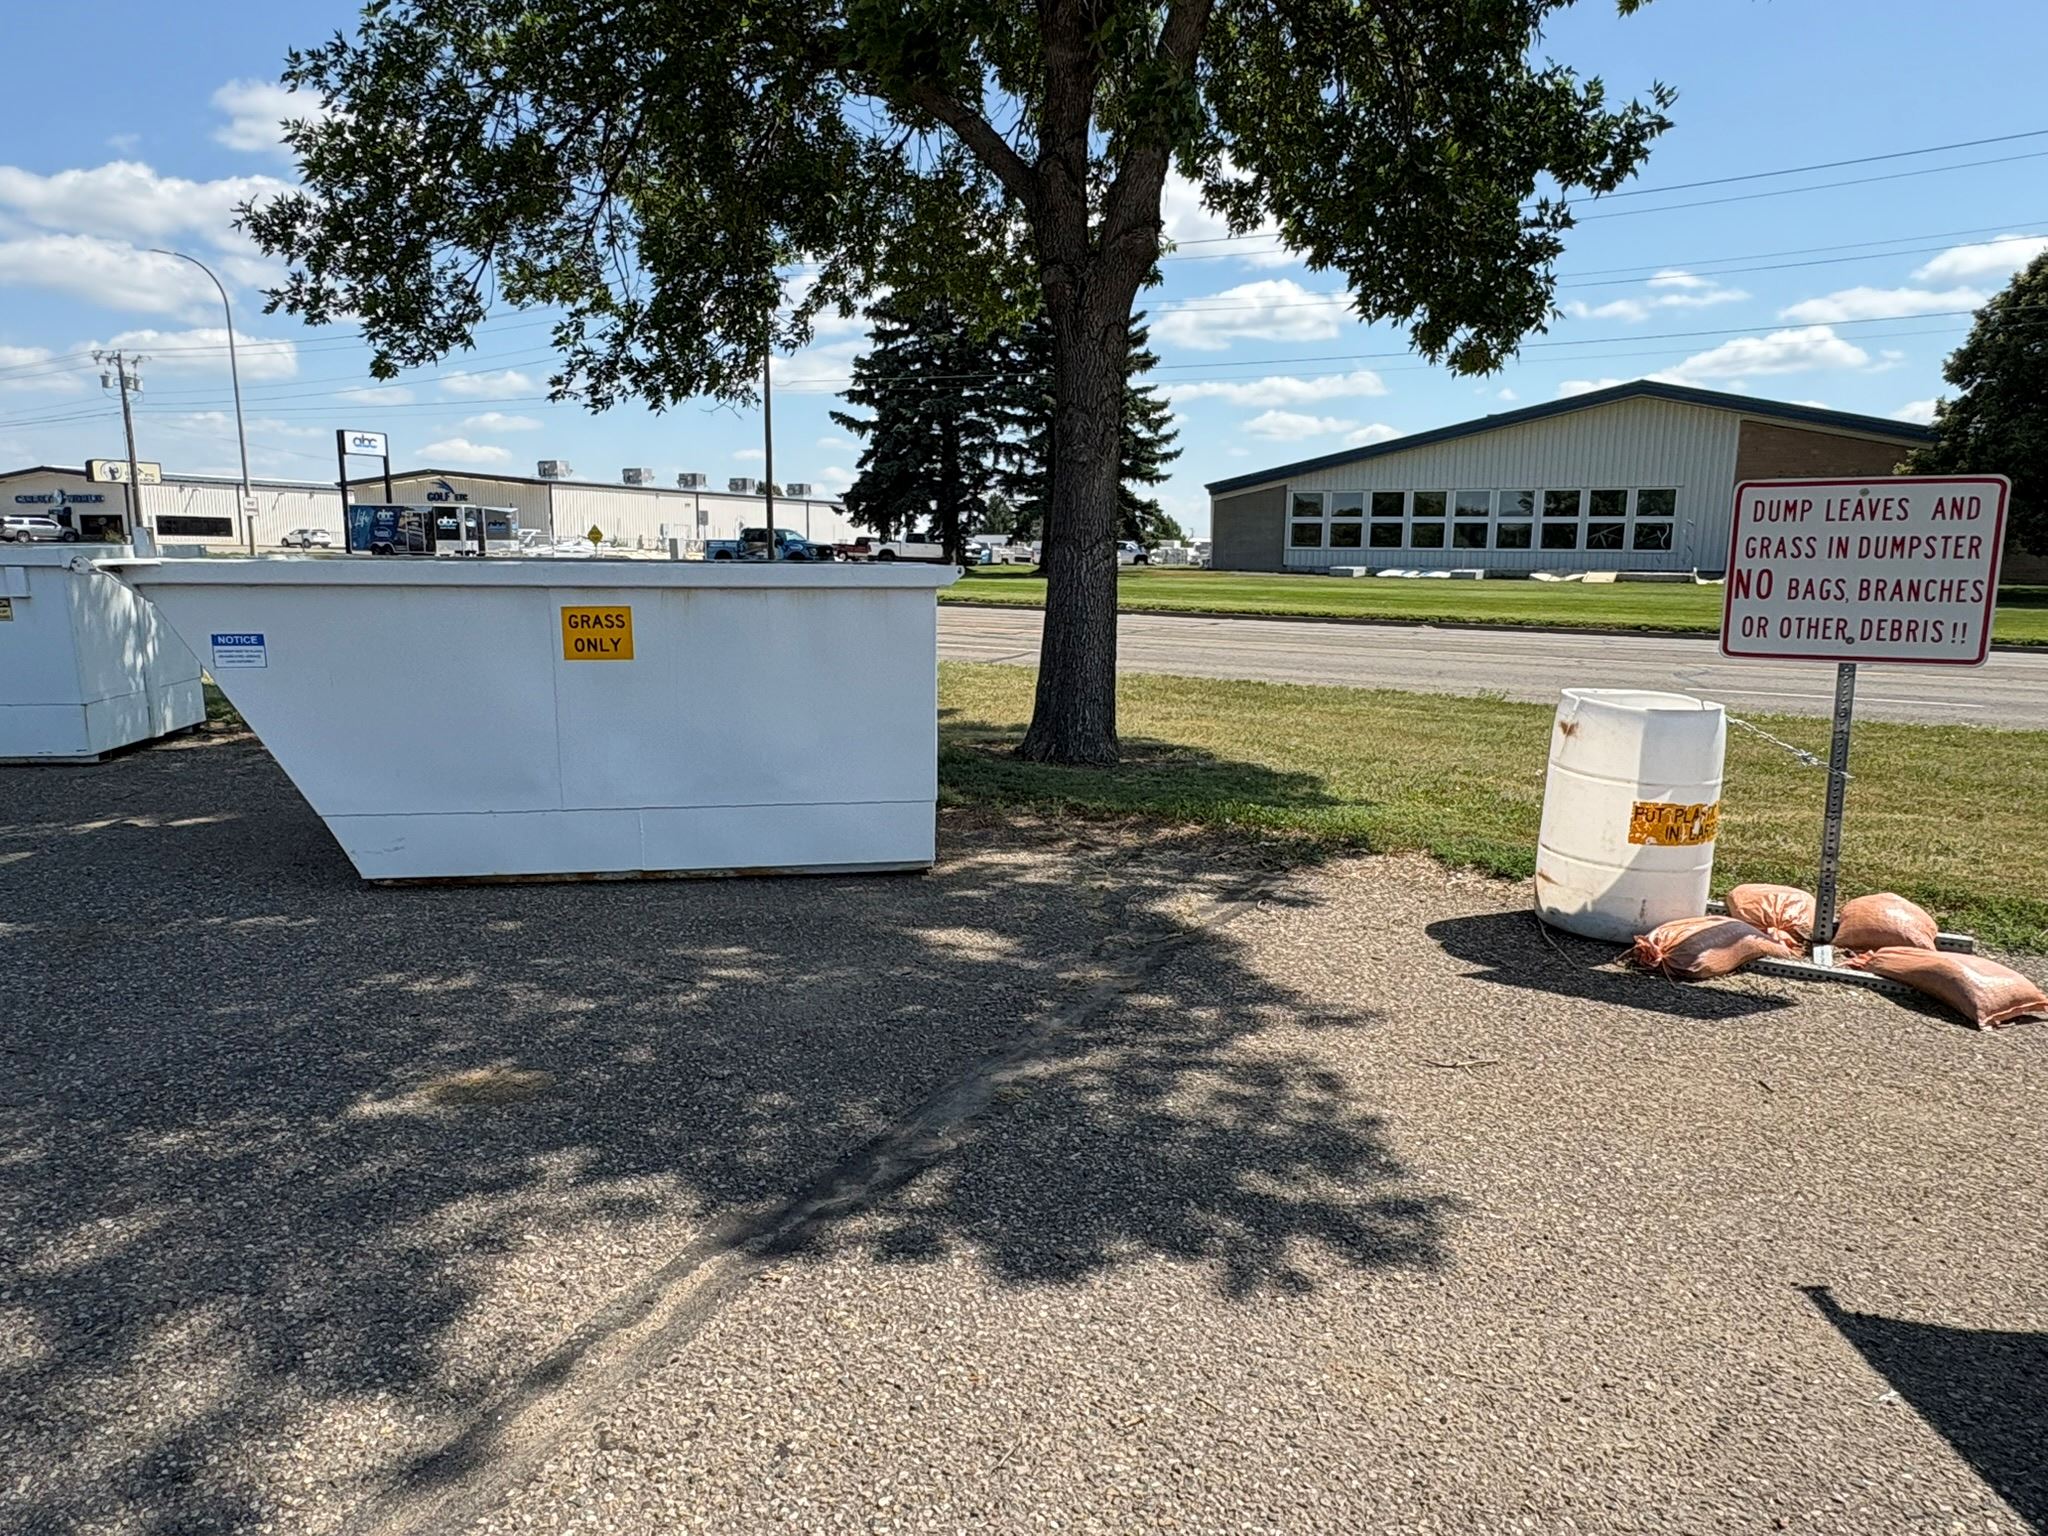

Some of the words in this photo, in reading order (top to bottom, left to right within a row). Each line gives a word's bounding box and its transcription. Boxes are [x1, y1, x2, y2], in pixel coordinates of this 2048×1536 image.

[427, 492, 450, 502] GOLF
[1753, 500, 1813, 523] DUMP
[1825, 498, 1909, 522] LEAVES
[1931, 496, 1981, 521] AND
[1745, 536, 1817, 559] GRASS
[1827, 536, 1849, 560] IN
[1858, 536, 1983, 560] DUMPSTER
[1734, 569, 1773, 600] NO
[1787, 578, 1849, 604] BAGS,
[1858, 579, 1985, 603] BRANCHES
[568, 614, 626, 629] GRASS
[1742, 616, 1769, 639] OR
[1779, 616, 1848, 641] OTHER
[217, 635, 259, 645] NOTICE
[574, 638, 622, 653] ONLY
[1634, 806, 1665, 823] PUT
[1665, 826, 1681, 842] IN
